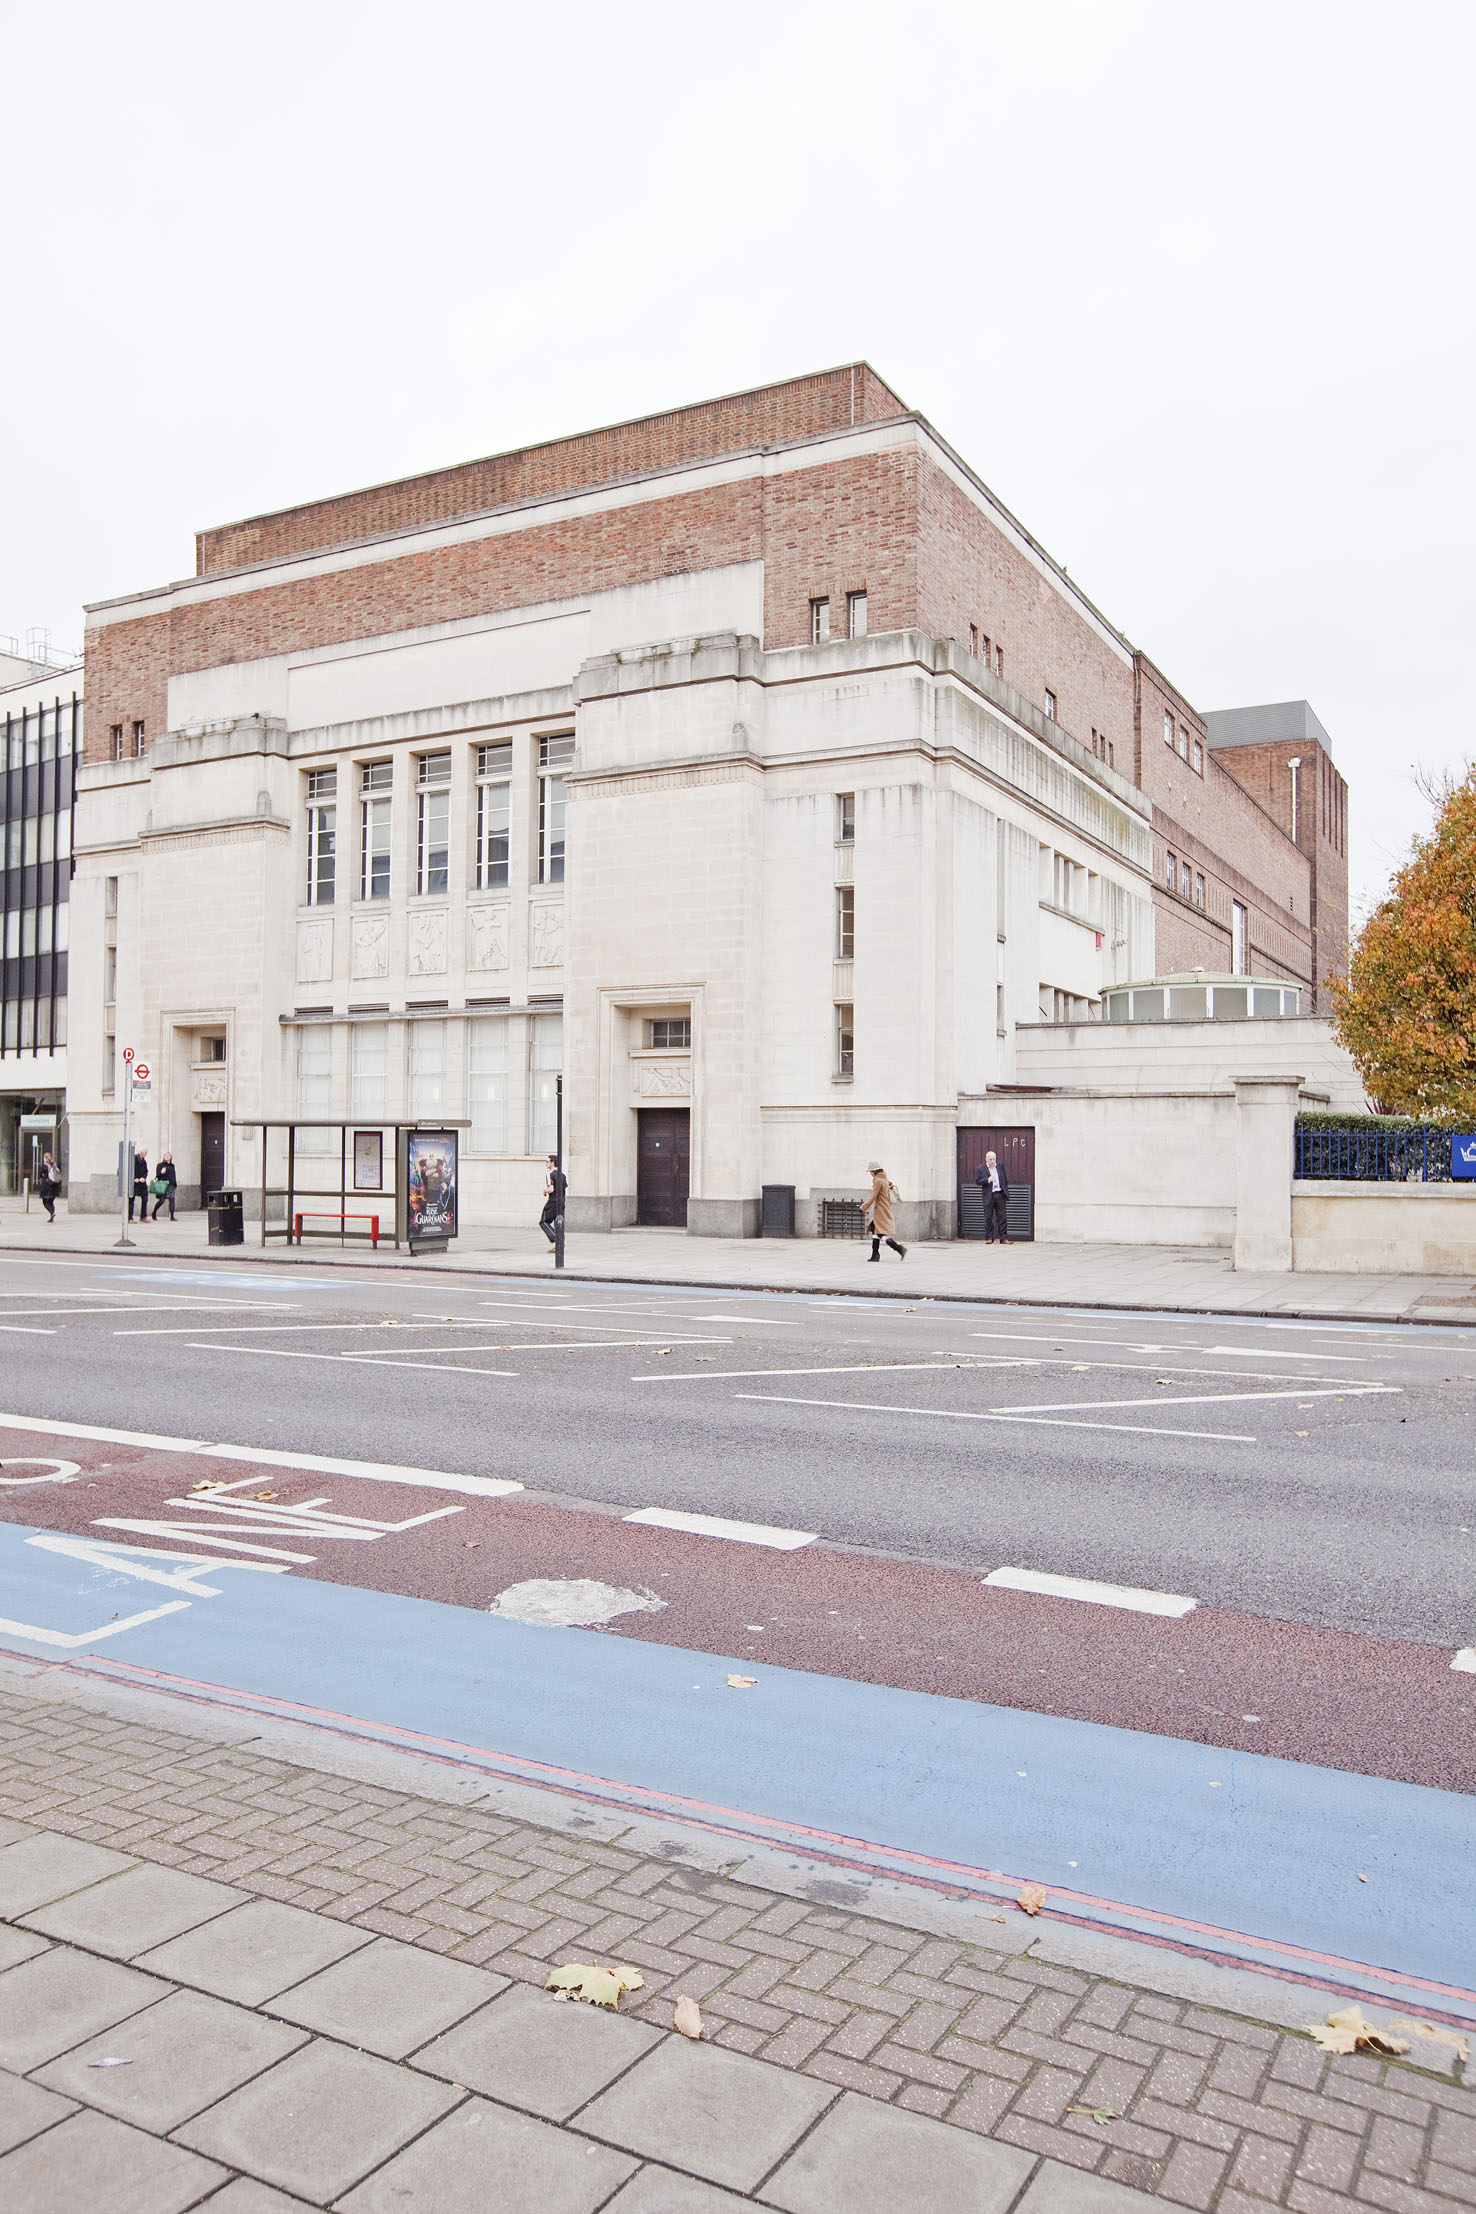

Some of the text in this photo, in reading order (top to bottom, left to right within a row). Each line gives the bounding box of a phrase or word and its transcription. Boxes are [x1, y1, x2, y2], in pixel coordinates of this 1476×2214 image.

[125, 1050, 133, 1060] D
[426, 1206, 438, 1215] RISE
[416, 1211, 448, 1225] GUARDIANS
